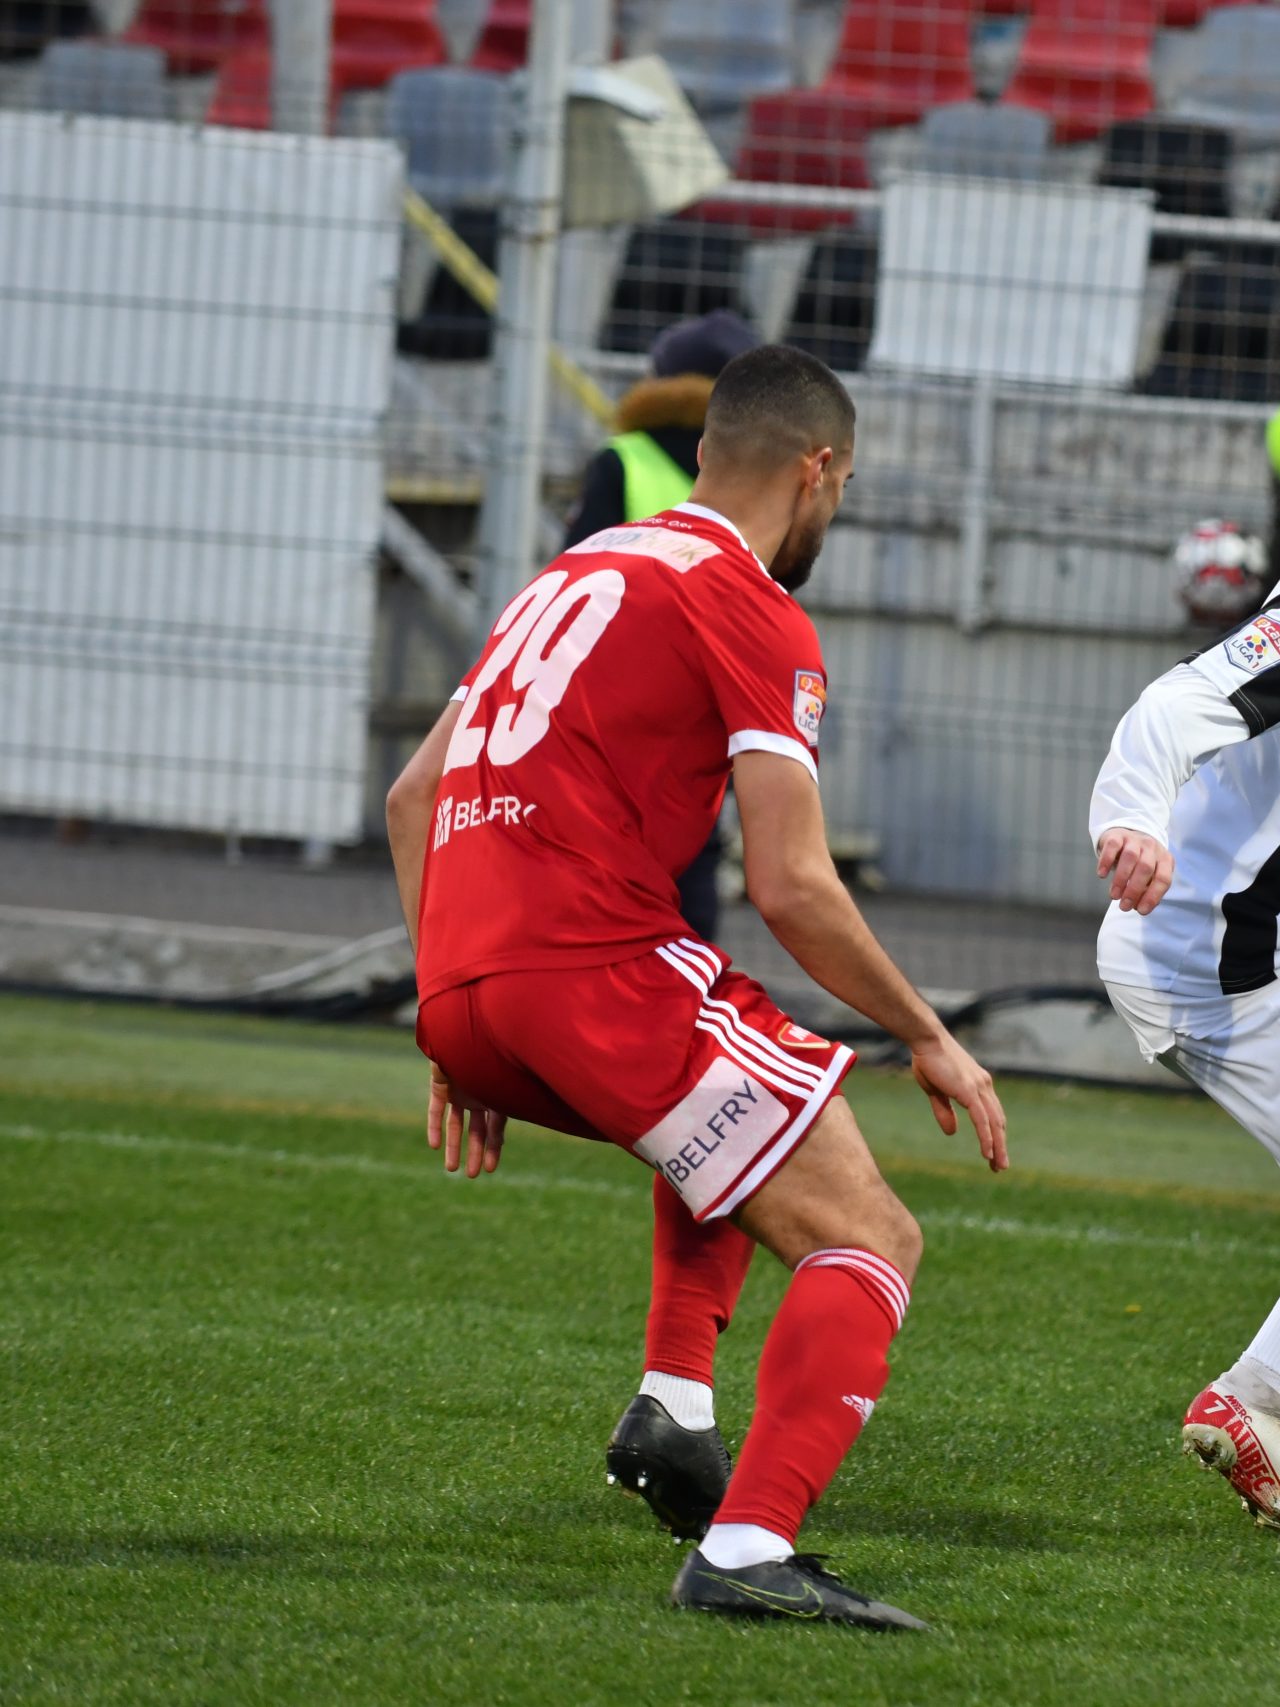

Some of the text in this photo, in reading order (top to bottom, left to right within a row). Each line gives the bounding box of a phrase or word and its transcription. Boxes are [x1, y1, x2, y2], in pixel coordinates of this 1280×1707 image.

[441, 568, 626, 777] 29
[1231, 639, 1254, 664] LIGA
[665, 1078, 759, 1183] BELFRY
[1203, 1400, 1228, 1415] 7
[1224, 1420, 1276, 1493] ALIBEC
